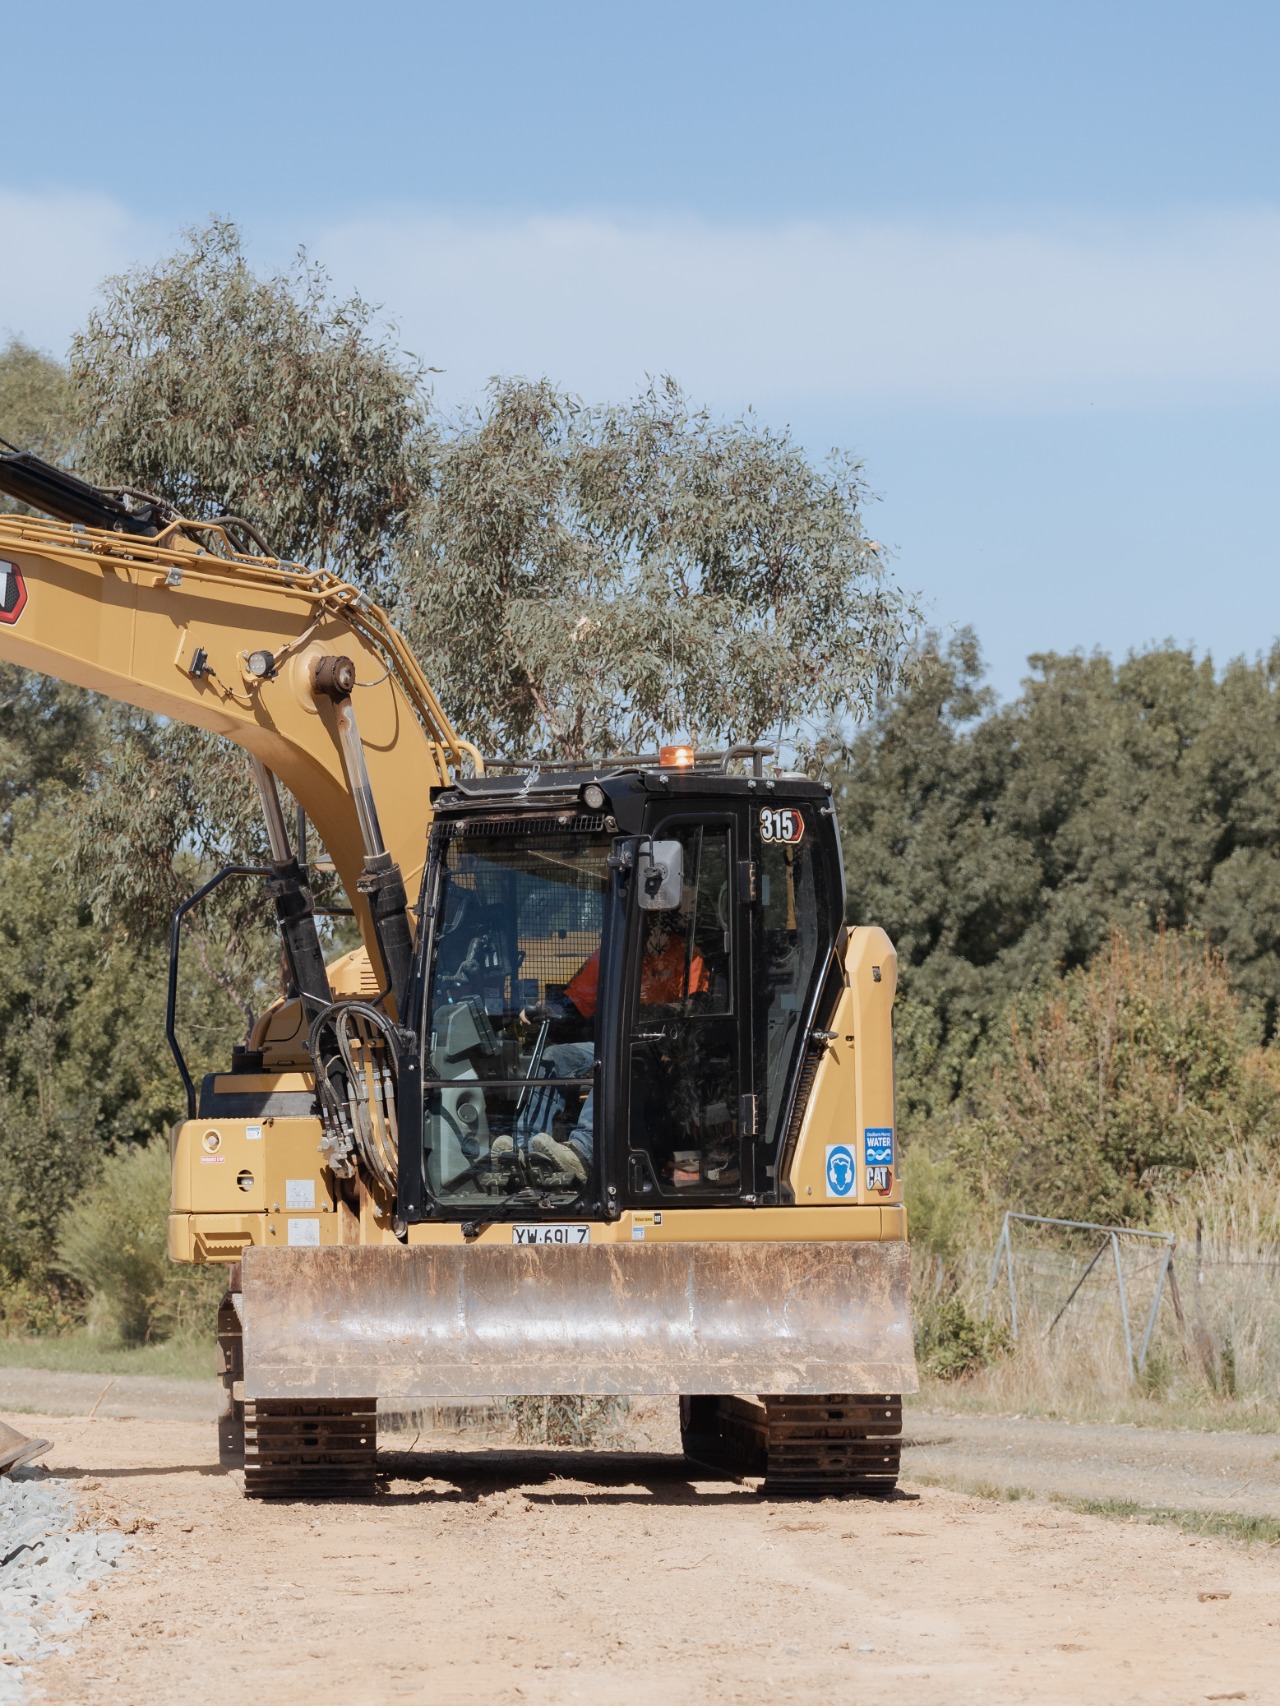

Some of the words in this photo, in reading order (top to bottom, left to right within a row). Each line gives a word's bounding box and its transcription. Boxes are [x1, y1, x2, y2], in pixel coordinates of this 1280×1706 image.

[761, 809, 793, 839] 315
[866, 1137, 891, 1147] WATER
[866, 1167, 888, 1190] CAT
